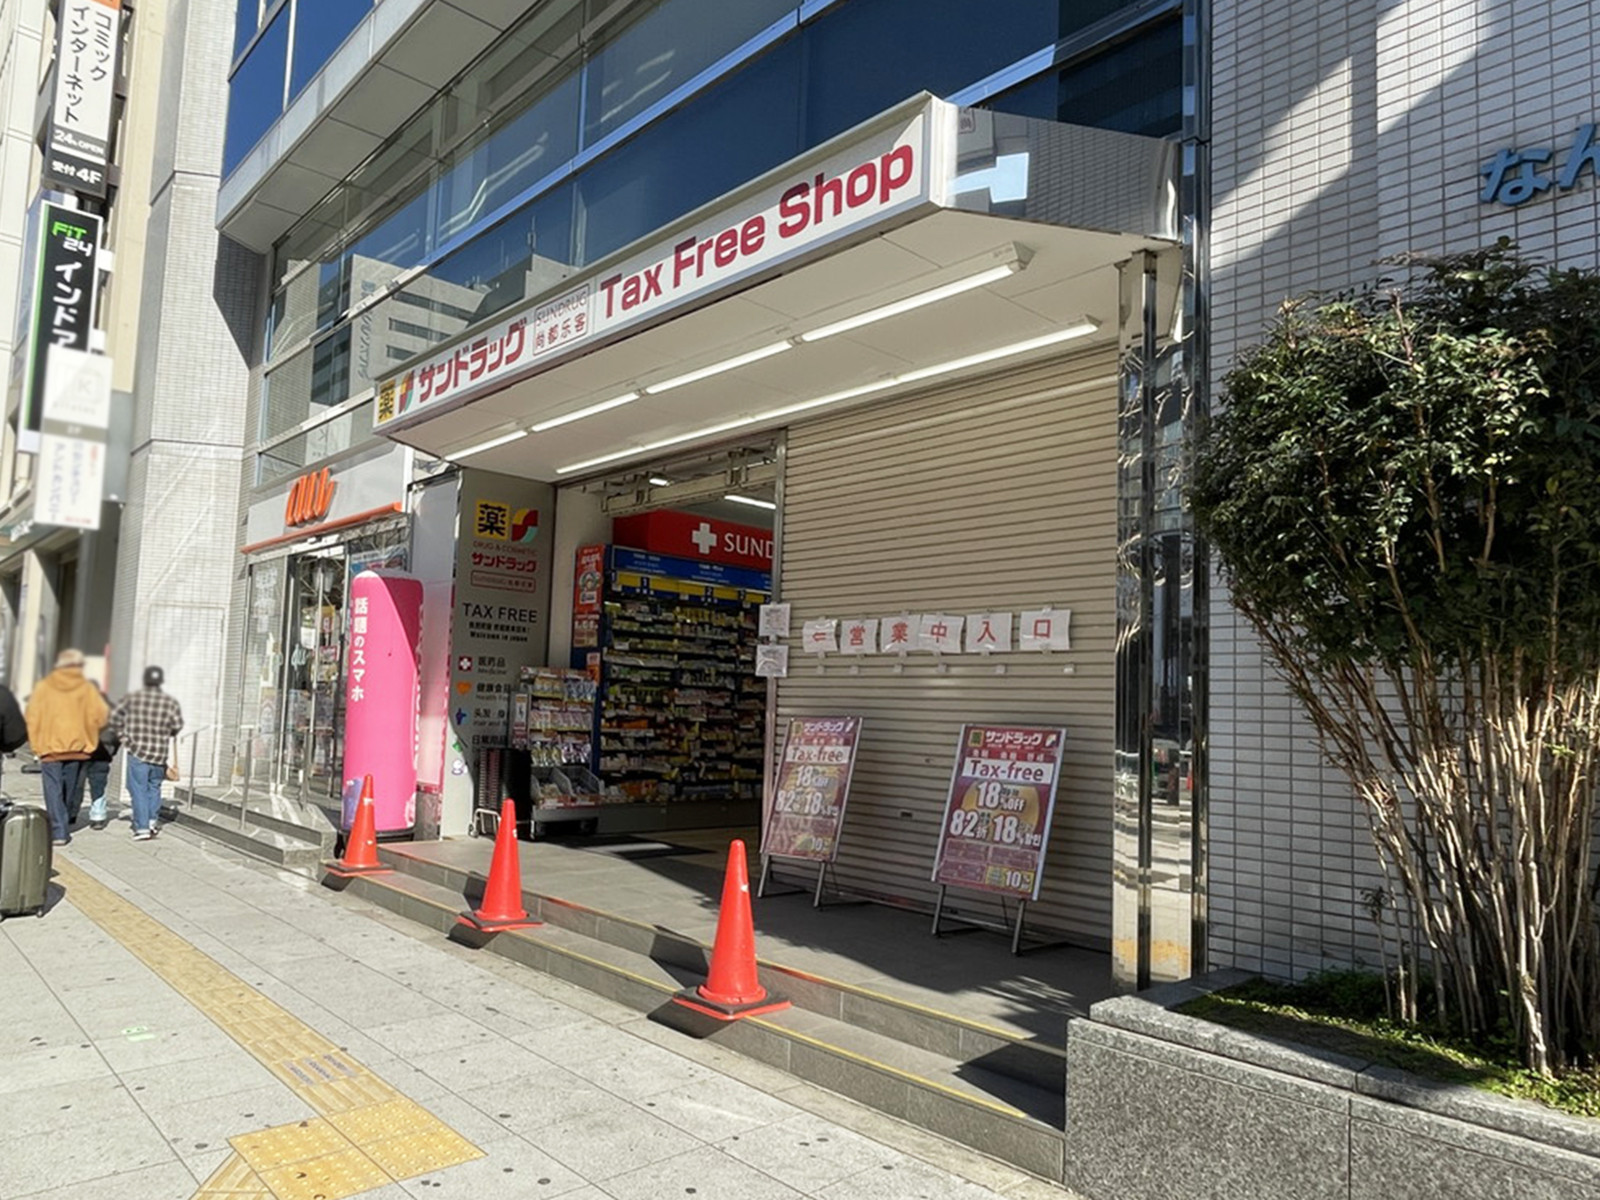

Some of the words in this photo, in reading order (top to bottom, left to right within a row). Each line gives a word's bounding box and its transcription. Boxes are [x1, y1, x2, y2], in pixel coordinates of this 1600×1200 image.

[90, 10, 111, 81] コミック
[64, 6, 90, 124] インターネット
[76, 168, 103, 184] 4F
[600, 273, 663, 319] Tax
[673, 215, 766, 289] Free
[778, 144, 914, 239] Shop
[63, 237, 93, 257] 24
[536, 289, 589, 327] SUNDRUG
[418, 316, 527, 403] サンドラッグ
[477, 503, 507, 537] 薬
[463, 602, 493, 619] TAX
[498, 607, 538, 623] FREE
[351, 597, 368, 703] 話題のスマホ
[792, 746, 844, 762] Tax-free
[796, 765, 814, 787] 18
[970, 759, 1044, 782] Tax-free
[804, 791, 823, 815] 18
[977, 781, 1001, 808] 18
[949, 809, 979, 837] 82
[994, 815, 1018, 844] 18
[1005, 871, 1021, 888] 10
